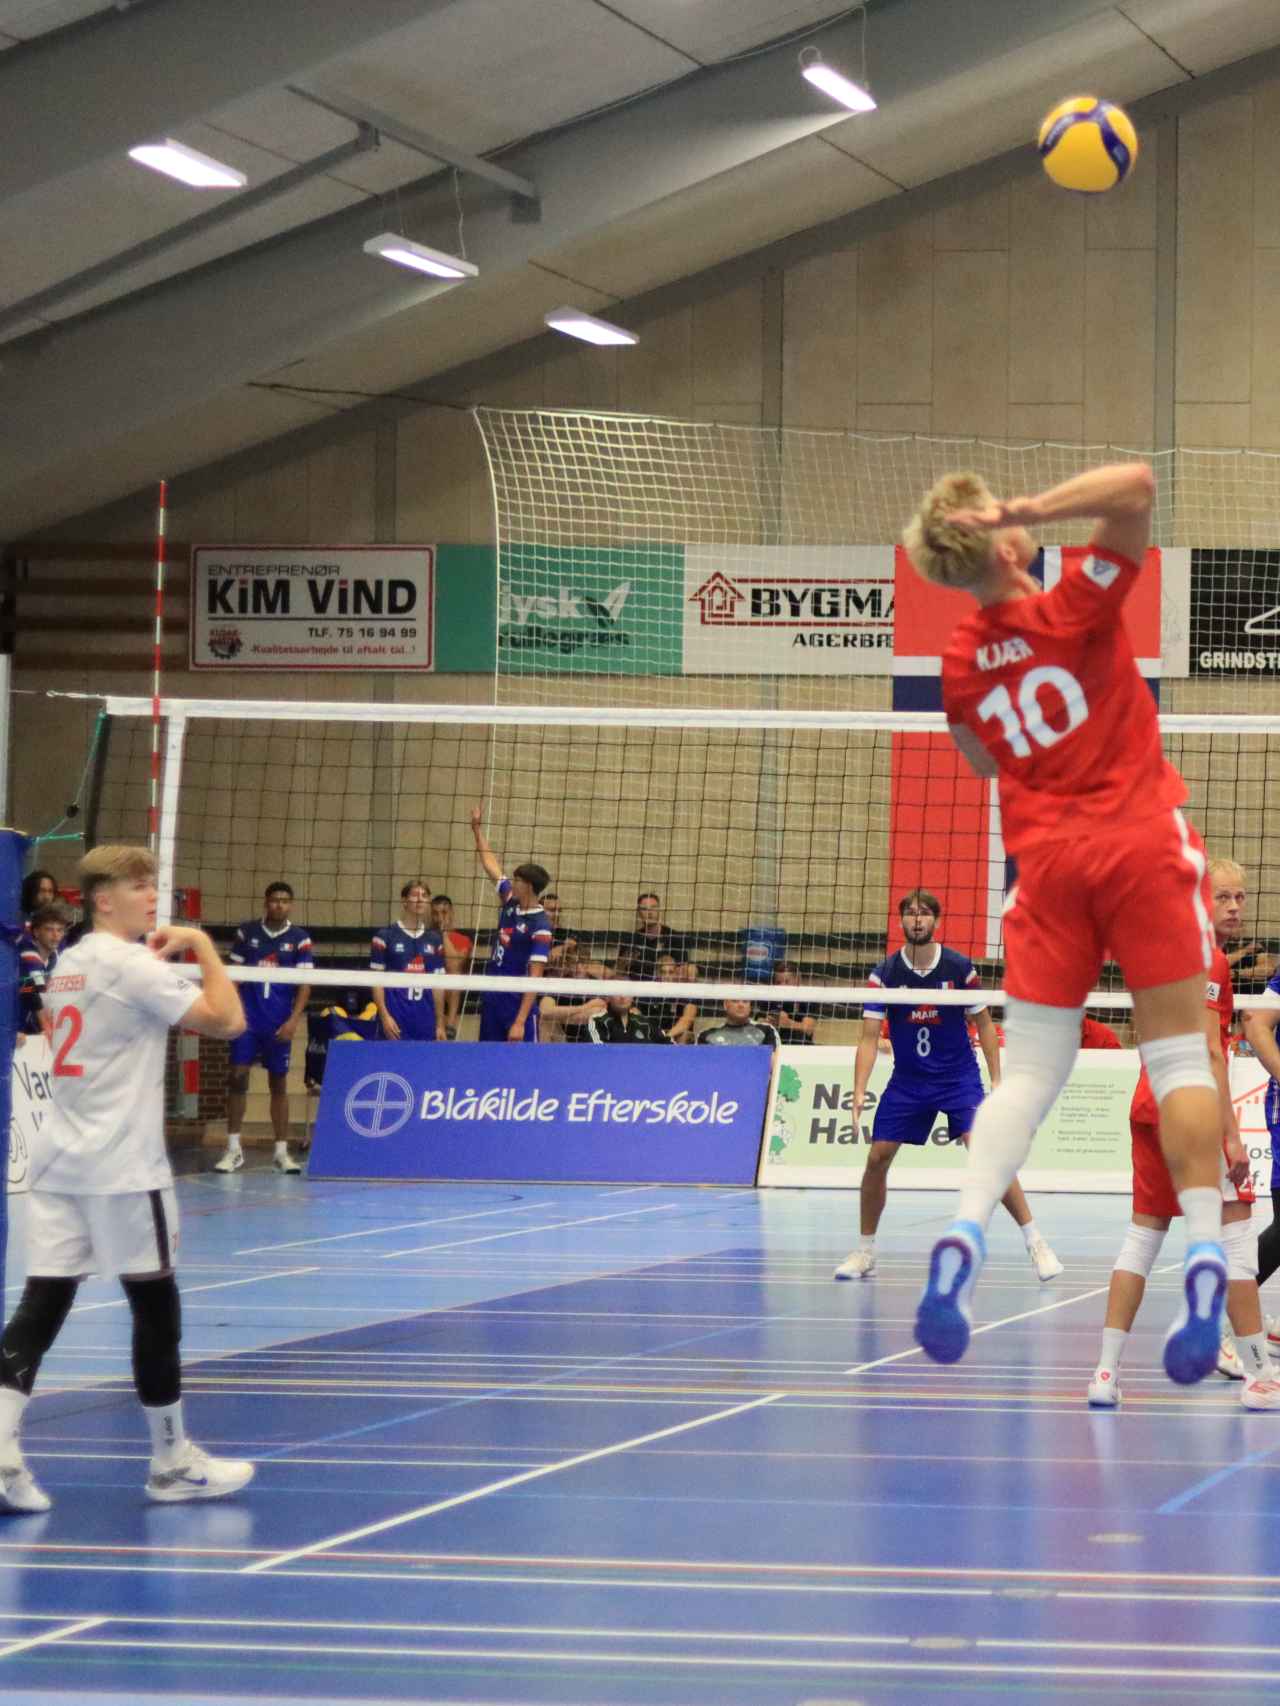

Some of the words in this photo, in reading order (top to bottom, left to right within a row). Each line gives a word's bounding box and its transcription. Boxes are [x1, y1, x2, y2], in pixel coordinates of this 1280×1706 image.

[207, 564, 341, 577] ENTREPRENØR
[308, 627, 332, 638] TLF.
[977, 665, 1089, 758] 10
[911, 1009, 939, 1021] MAIF
[916, 1026, 931, 1057] 8
[421, 1088, 558, 1122] Blåkilde
[567, 1089, 739, 1125] Efterskole
